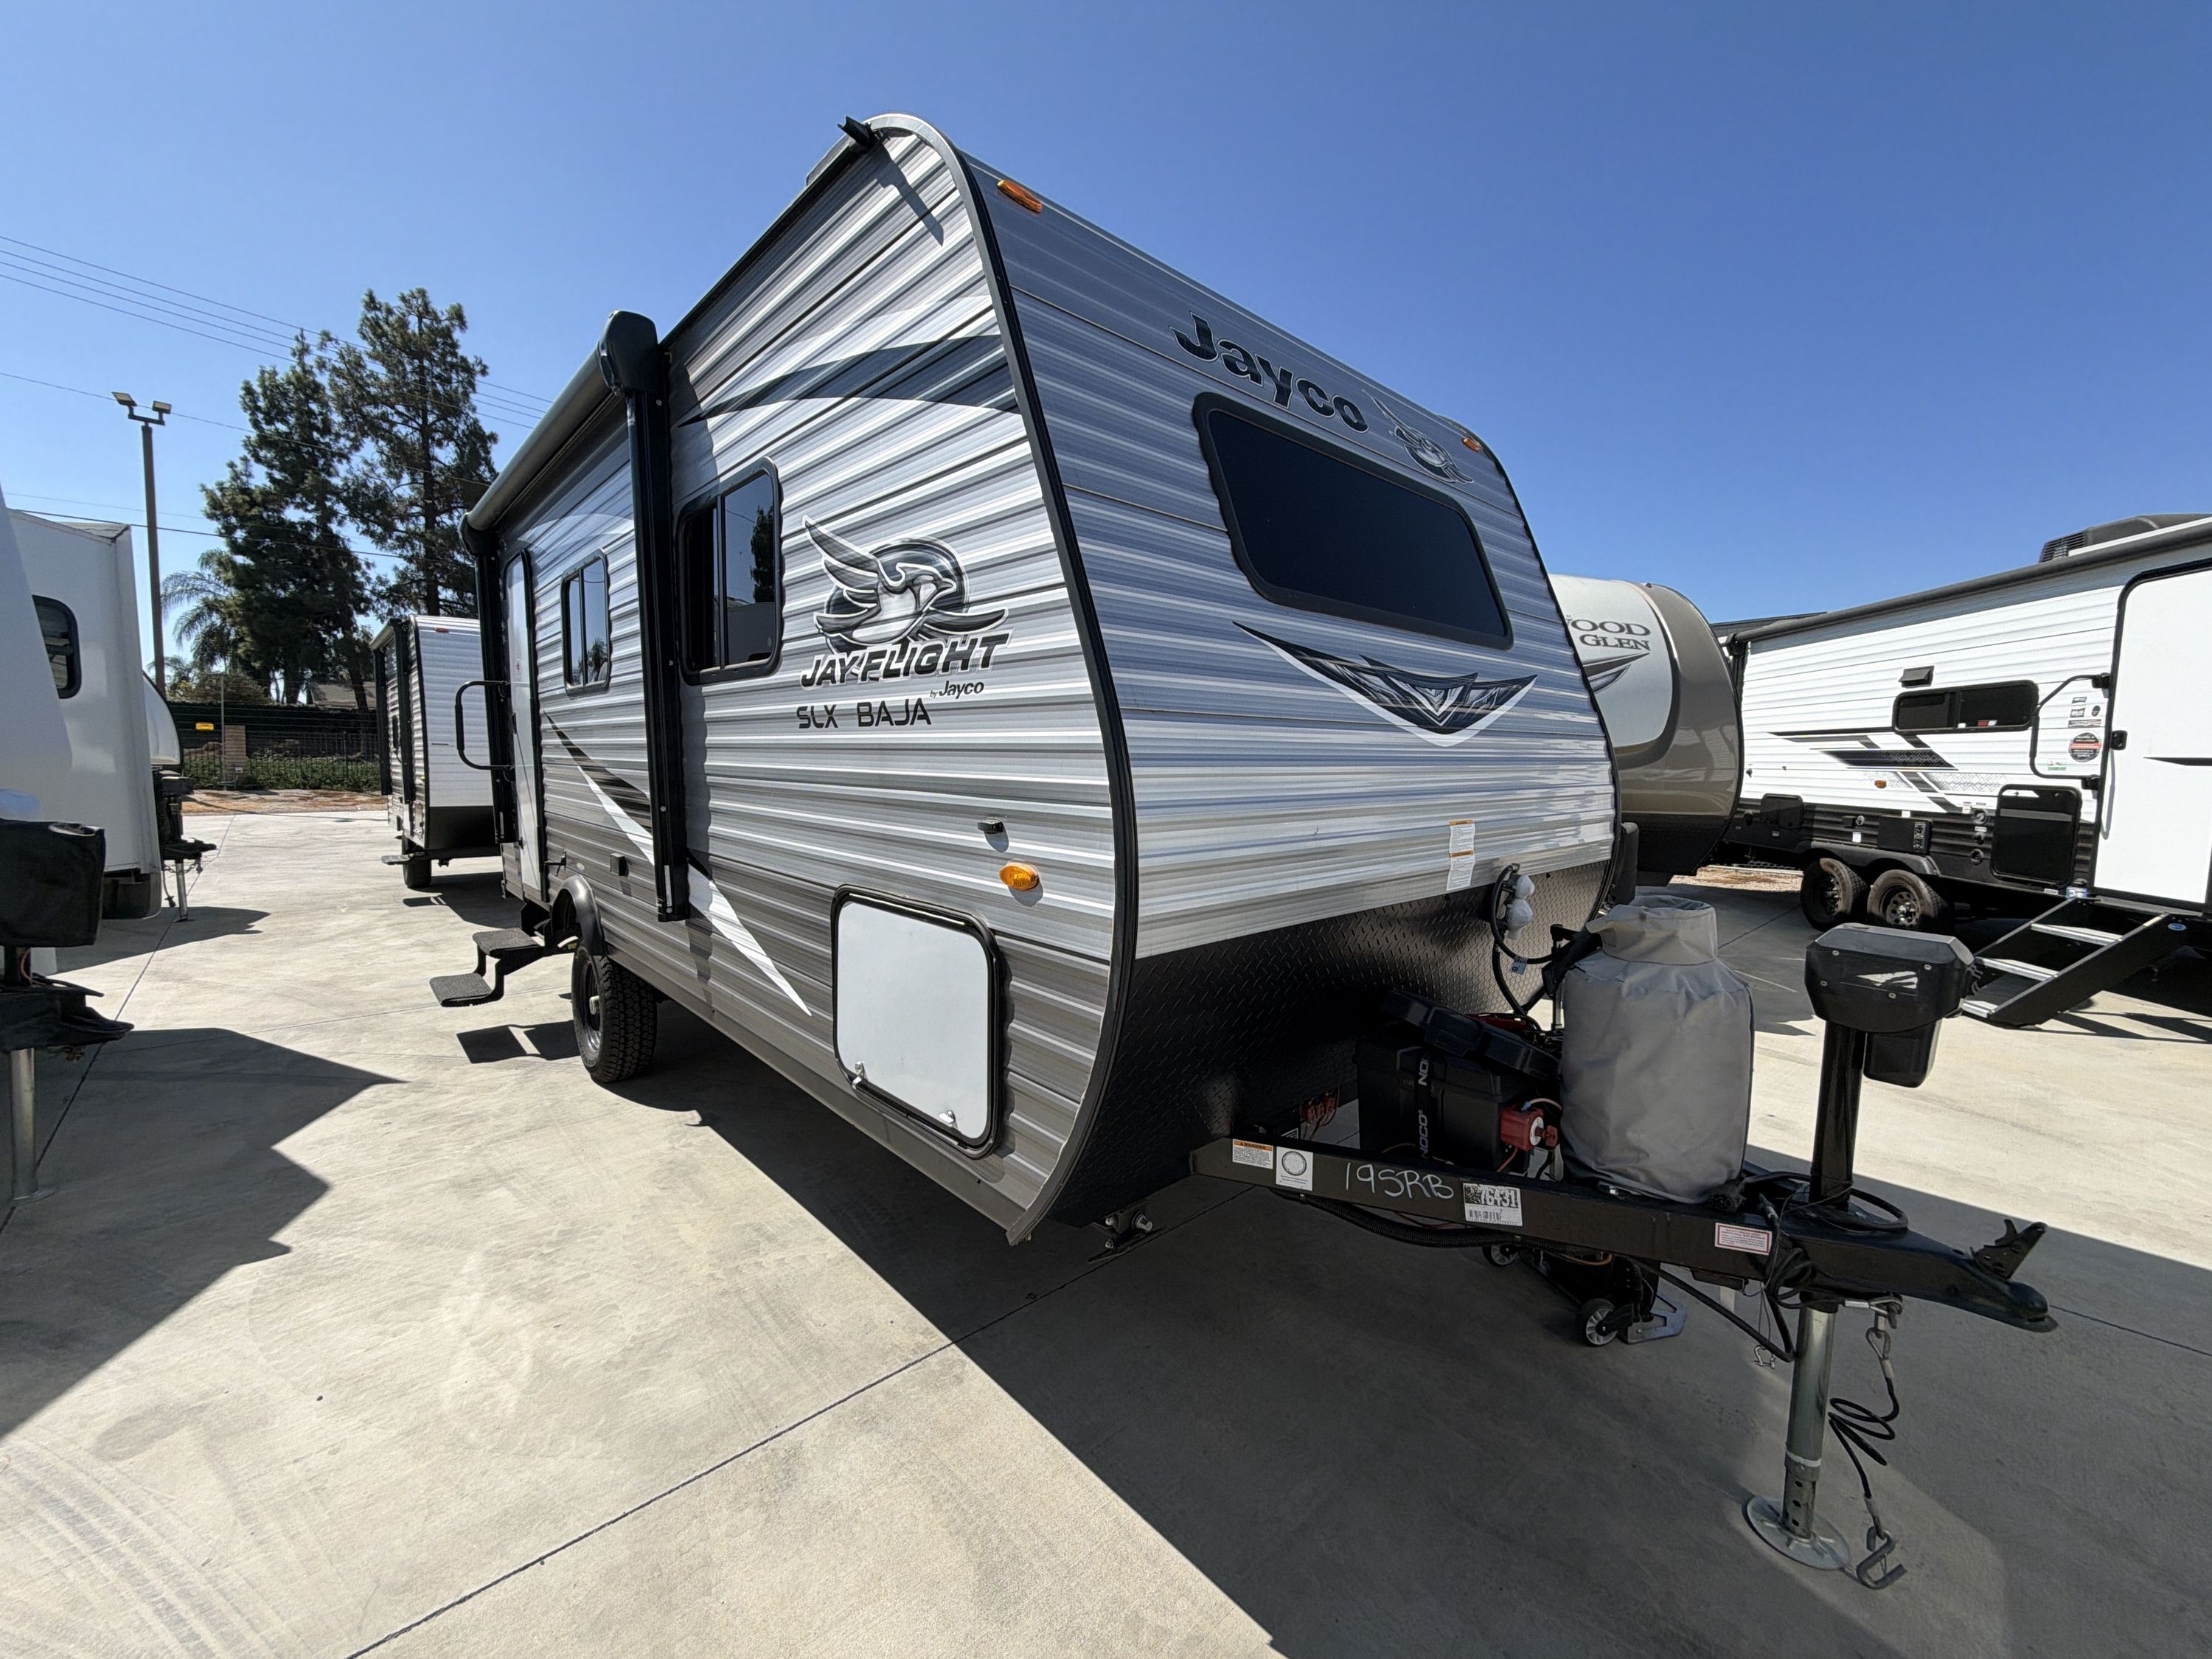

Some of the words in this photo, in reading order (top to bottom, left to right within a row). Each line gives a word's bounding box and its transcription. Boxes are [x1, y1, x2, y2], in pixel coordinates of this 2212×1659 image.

[1169, 311, 1370, 434] Jayco
[1579, 634, 1651, 651] GLEN
[930, 690, 938, 698] by
[939, 680, 984, 699] Jayco
[796, 703, 838, 728] SLX
[857, 698, 932, 727] BAJA
